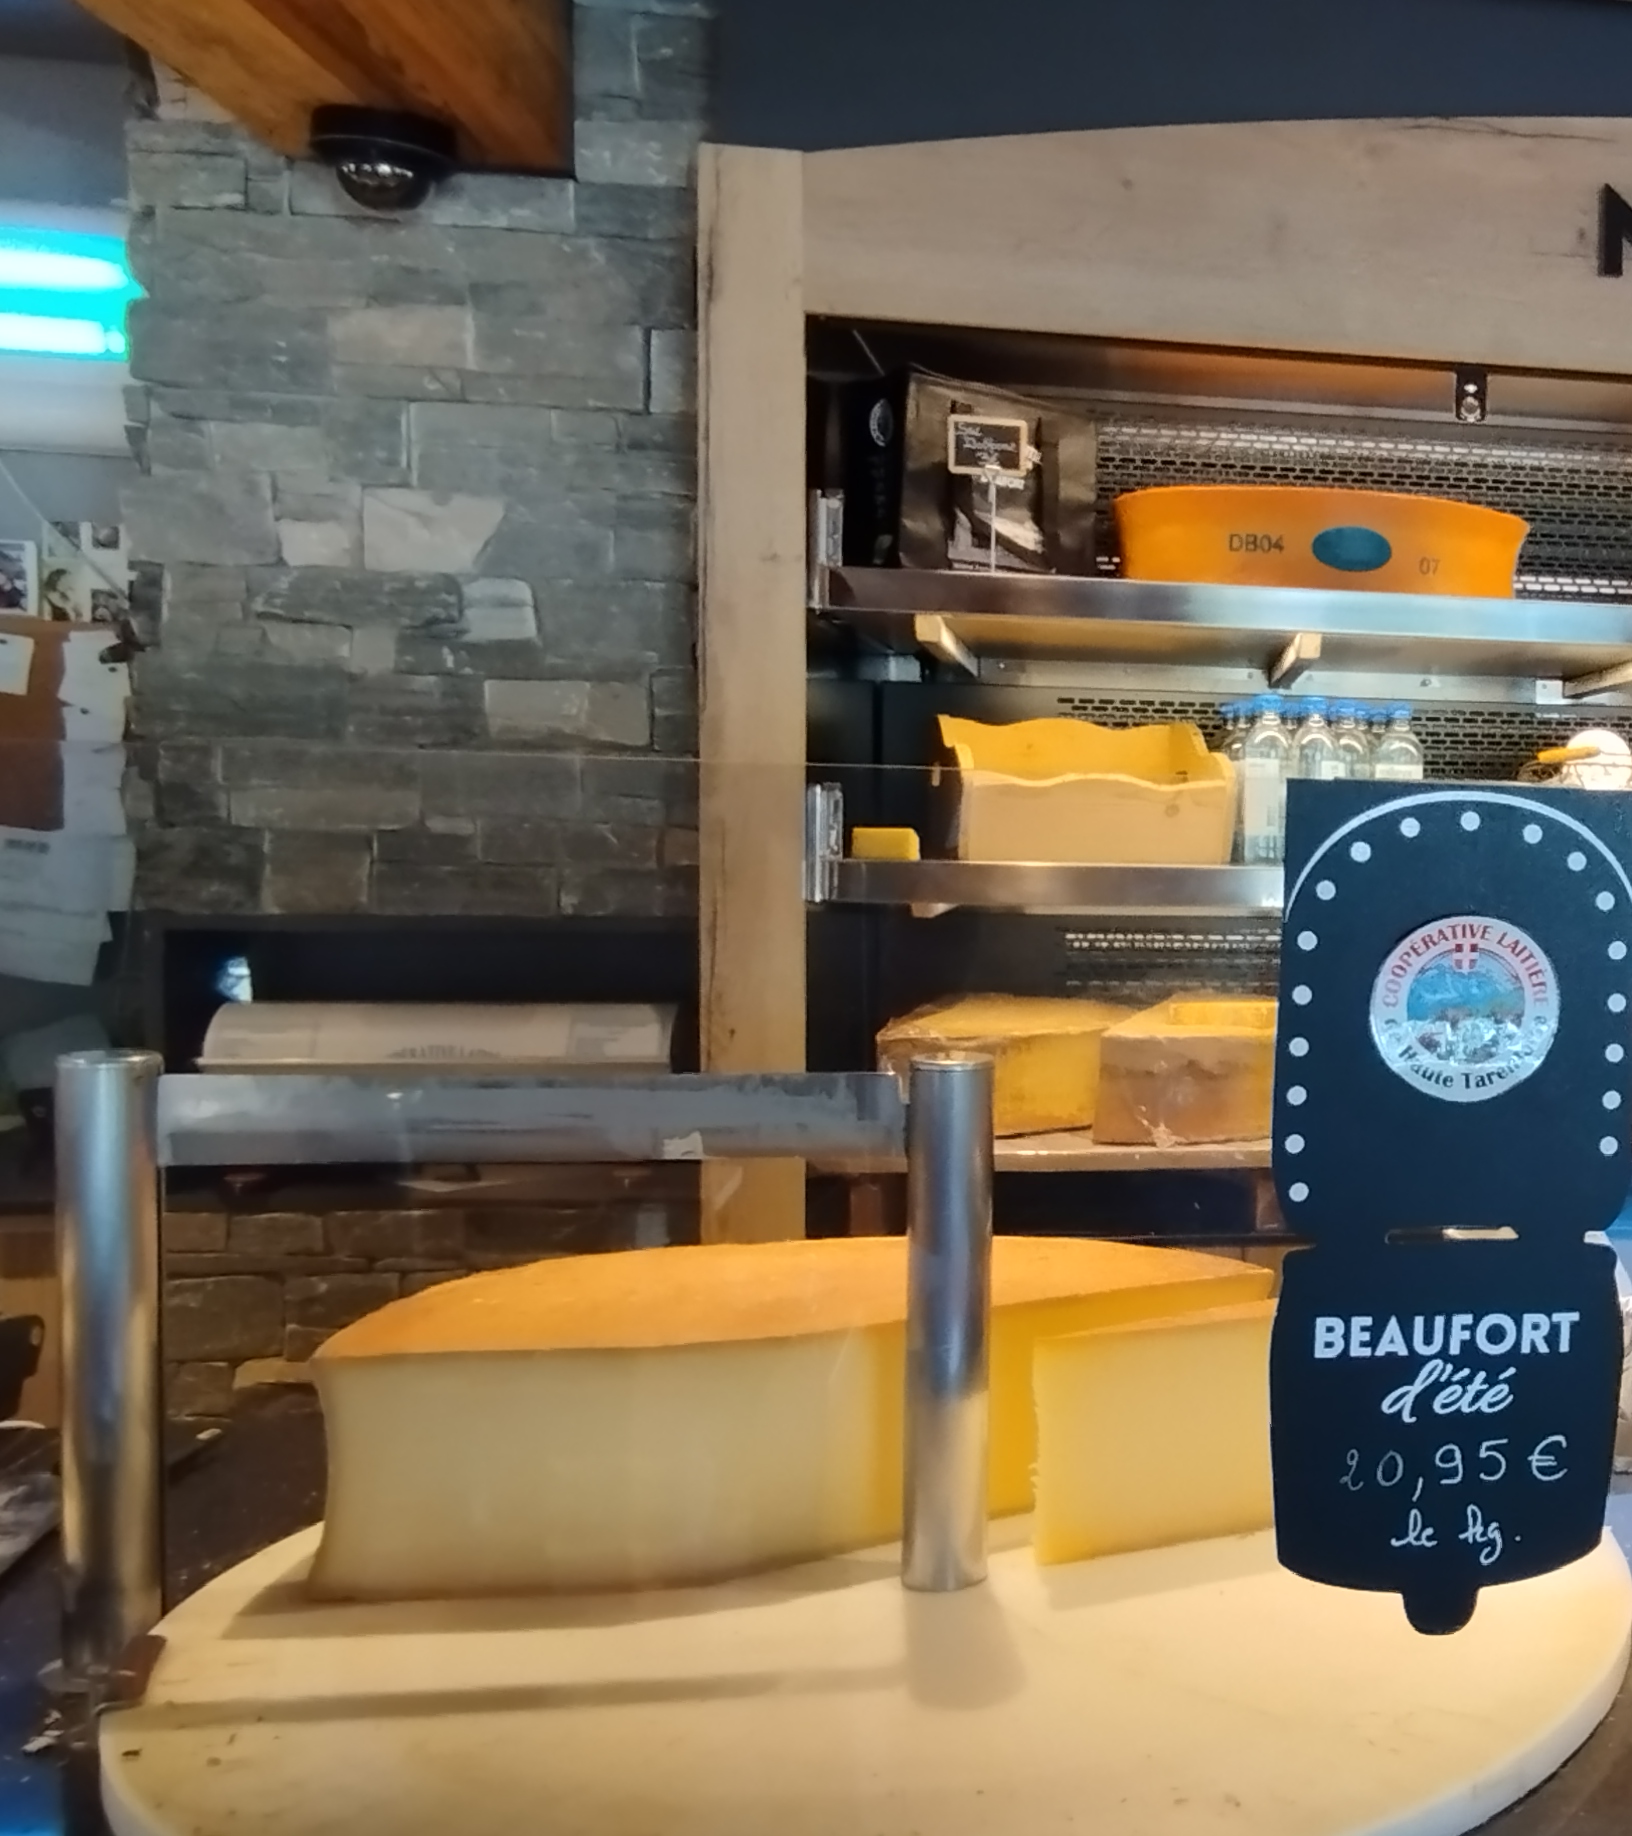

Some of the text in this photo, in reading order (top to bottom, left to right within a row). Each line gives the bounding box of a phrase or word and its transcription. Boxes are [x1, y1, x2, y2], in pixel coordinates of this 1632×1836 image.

[1228, 533, 1285, 554] DB04
[1418, 556, 1441, 576] 07
[1398, 1045, 1454, 1088] Haute
[1313, 1311, 1581, 1359] BEAUFORT
[1380, 1358, 1517, 1423] d'été
[1390, 1508, 1438, 1547] le
